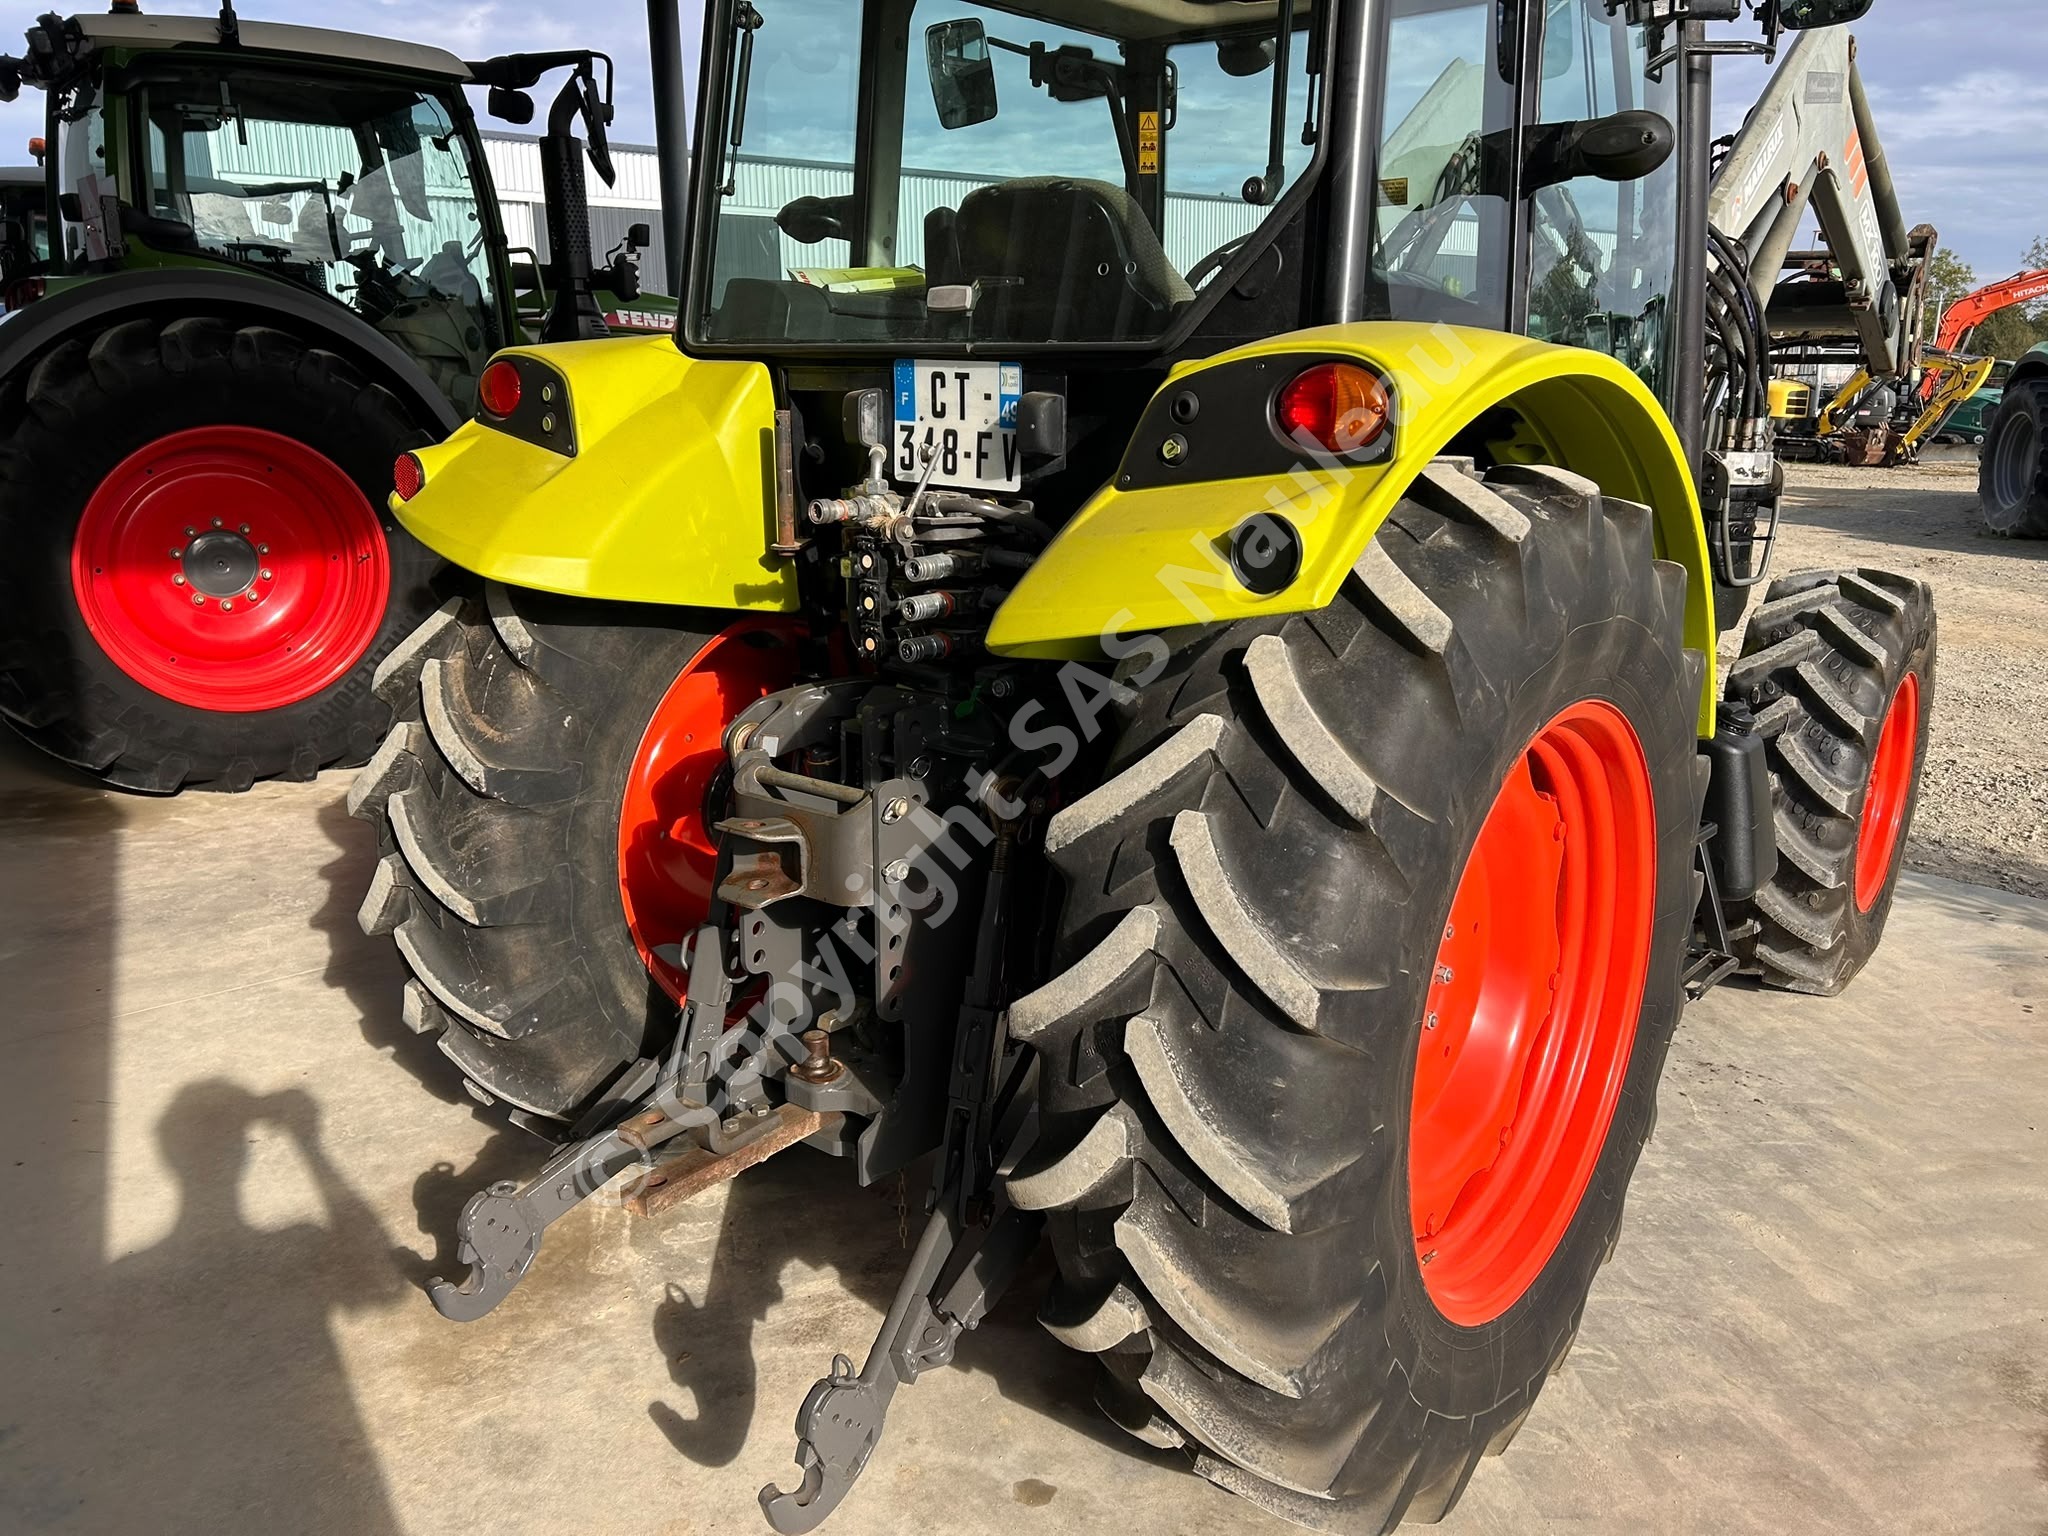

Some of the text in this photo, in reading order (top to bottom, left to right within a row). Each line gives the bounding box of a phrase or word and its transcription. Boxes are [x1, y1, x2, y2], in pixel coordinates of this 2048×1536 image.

[616, 309, 677, 329] FEND
[901, 392, 909, 405] F
[1001, 400, 1018, 422] 49
